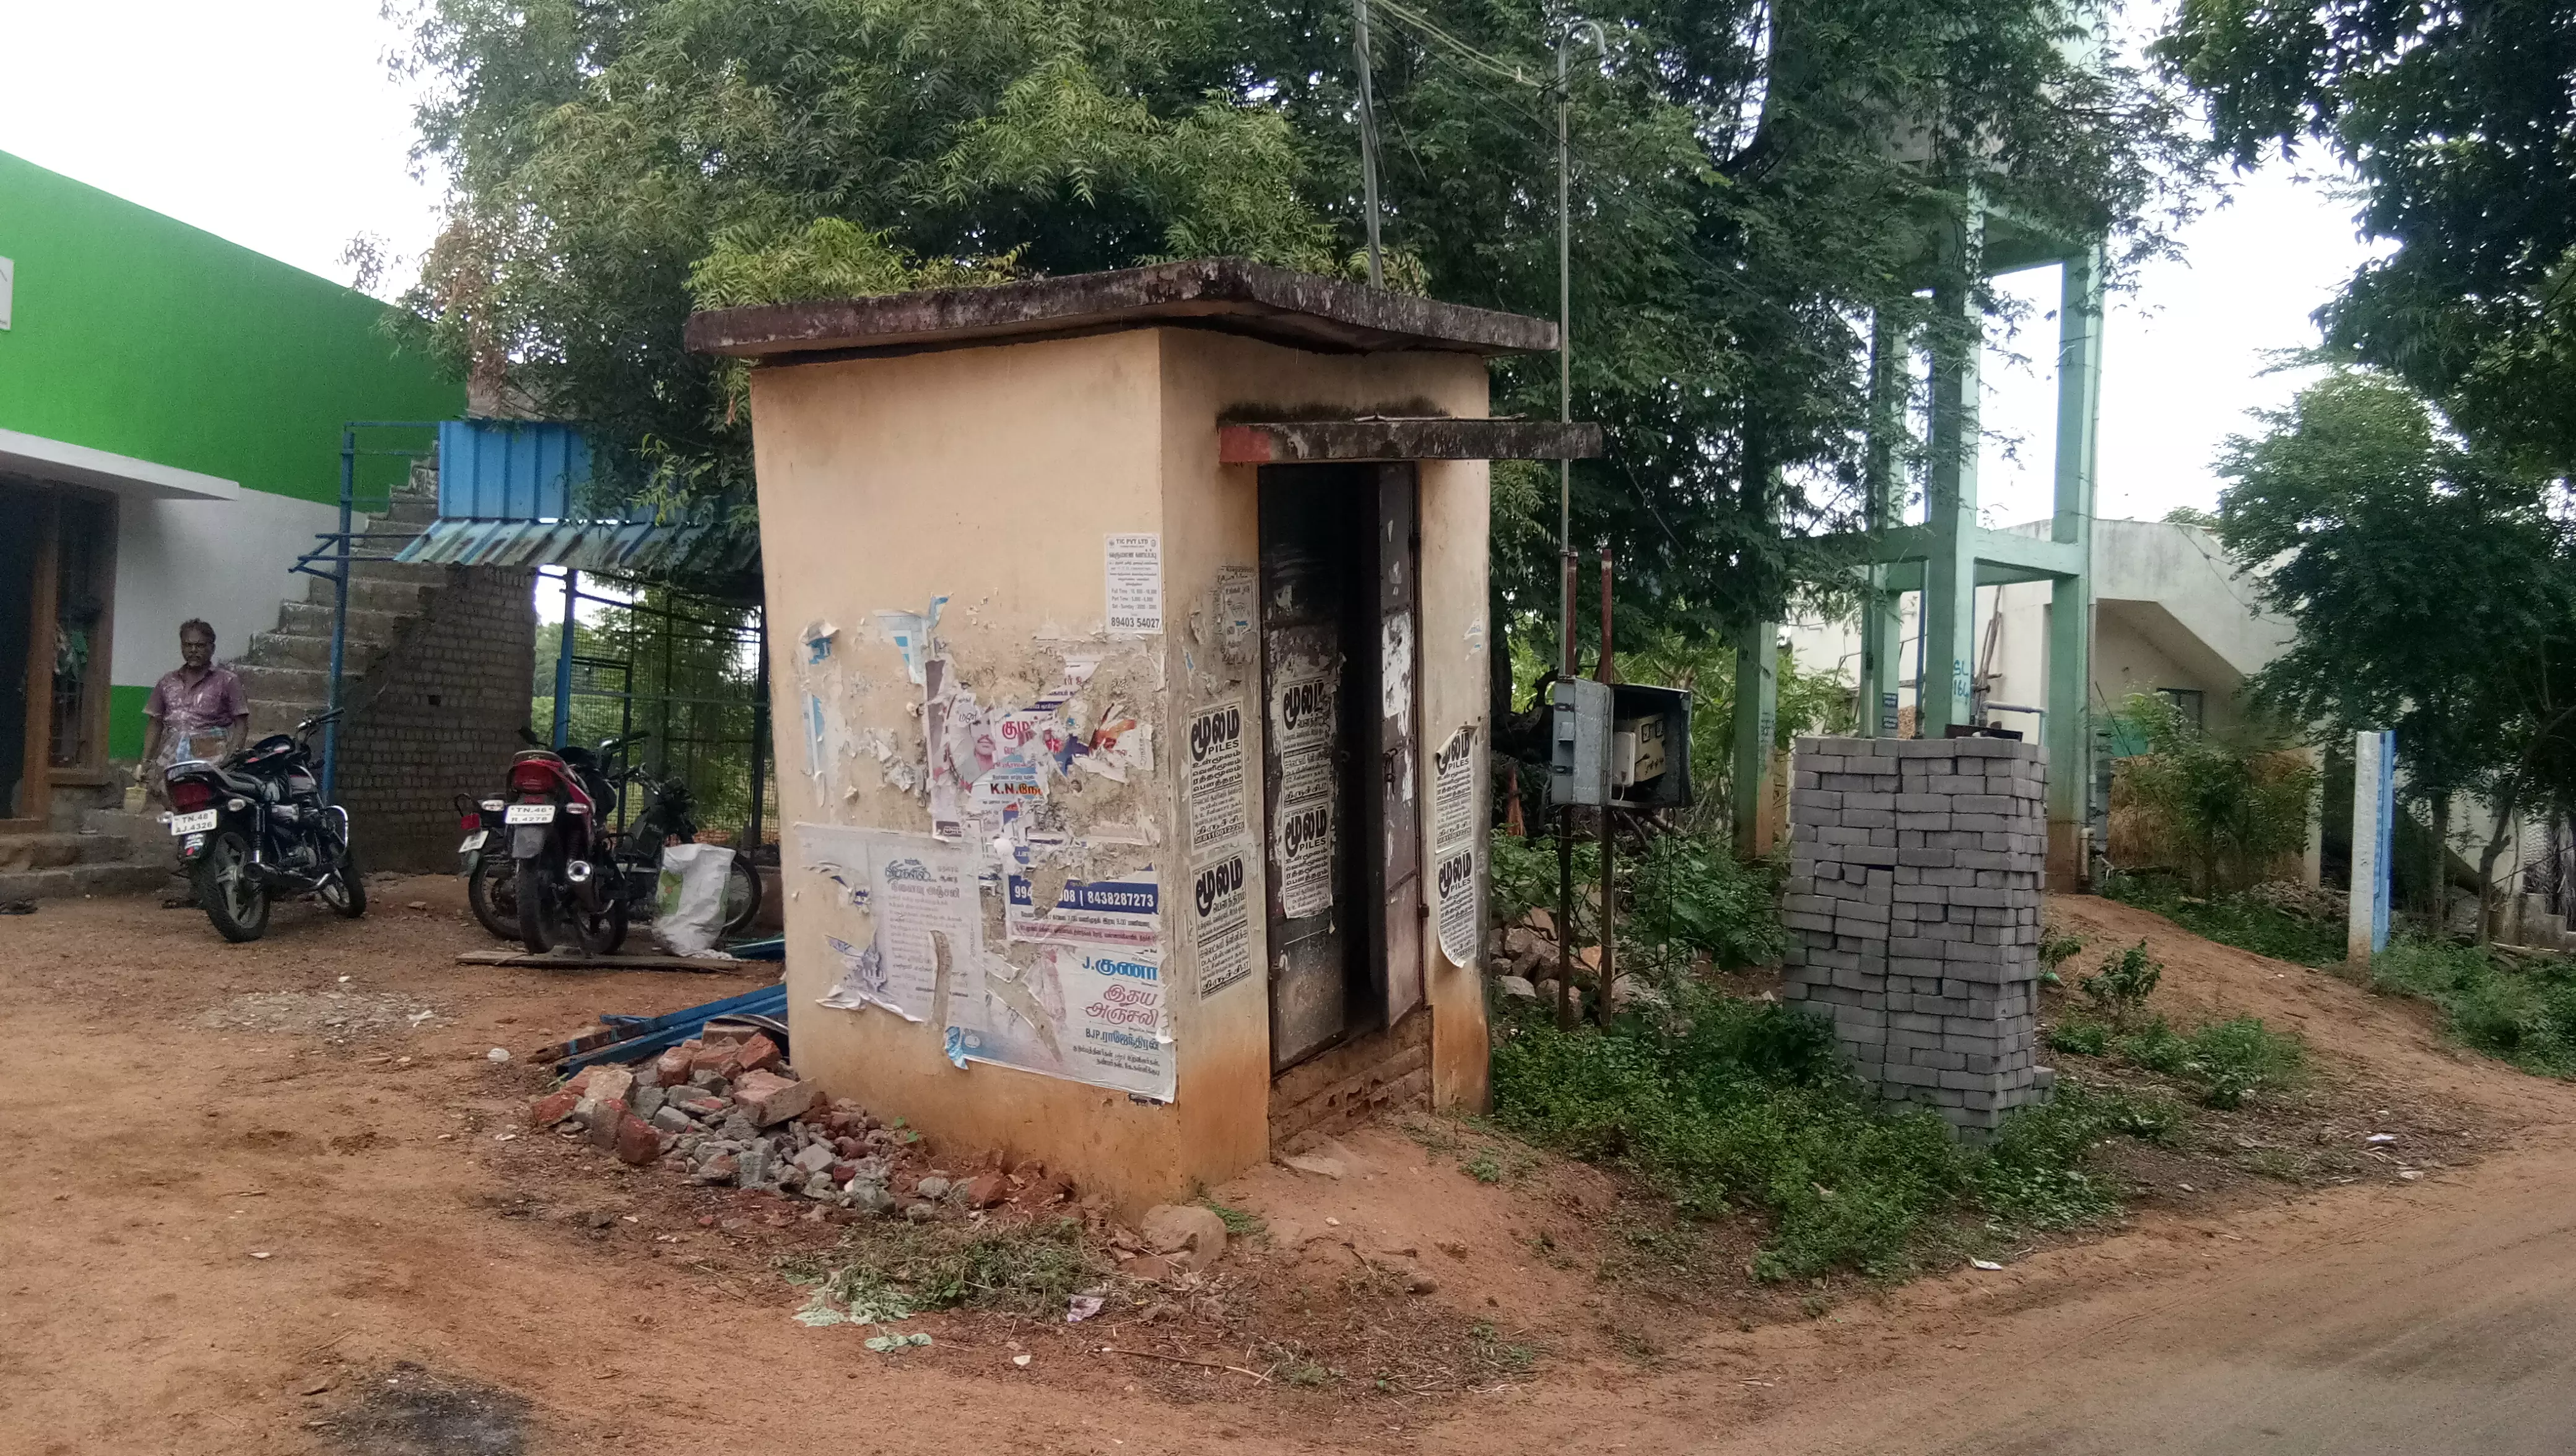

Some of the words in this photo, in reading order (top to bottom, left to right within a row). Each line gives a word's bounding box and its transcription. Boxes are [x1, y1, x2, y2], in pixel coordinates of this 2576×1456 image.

[1112, 617, 1134, 627] 89403
[1137, 618, 1159, 628] 54027
[1191, 705, 1240, 761] மூலம்
[1208, 740, 1239, 755] PILES
[1192, 750, 1241, 768] உள்மூலம்
[1193, 758, 1241, 776] வெளிமூலம்
[1448, 758, 1469, 770] PILES
[1285, 806, 1326, 857] மூலம்
[1300, 838, 1326, 851] PILES
[1438, 849, 1471, 898] மூலம்
[1196, 856, 1243, 917] மூலம்
[1450, 877, 1471, 892] PILES
[1087, 891, 1154, 908] 8438287273
[1082, 956, 1158, 981] J.குணா
[1103, 984, 1158, 1007] இதய
[1086, 1002, 1159, 1028] அஞ்சலி
